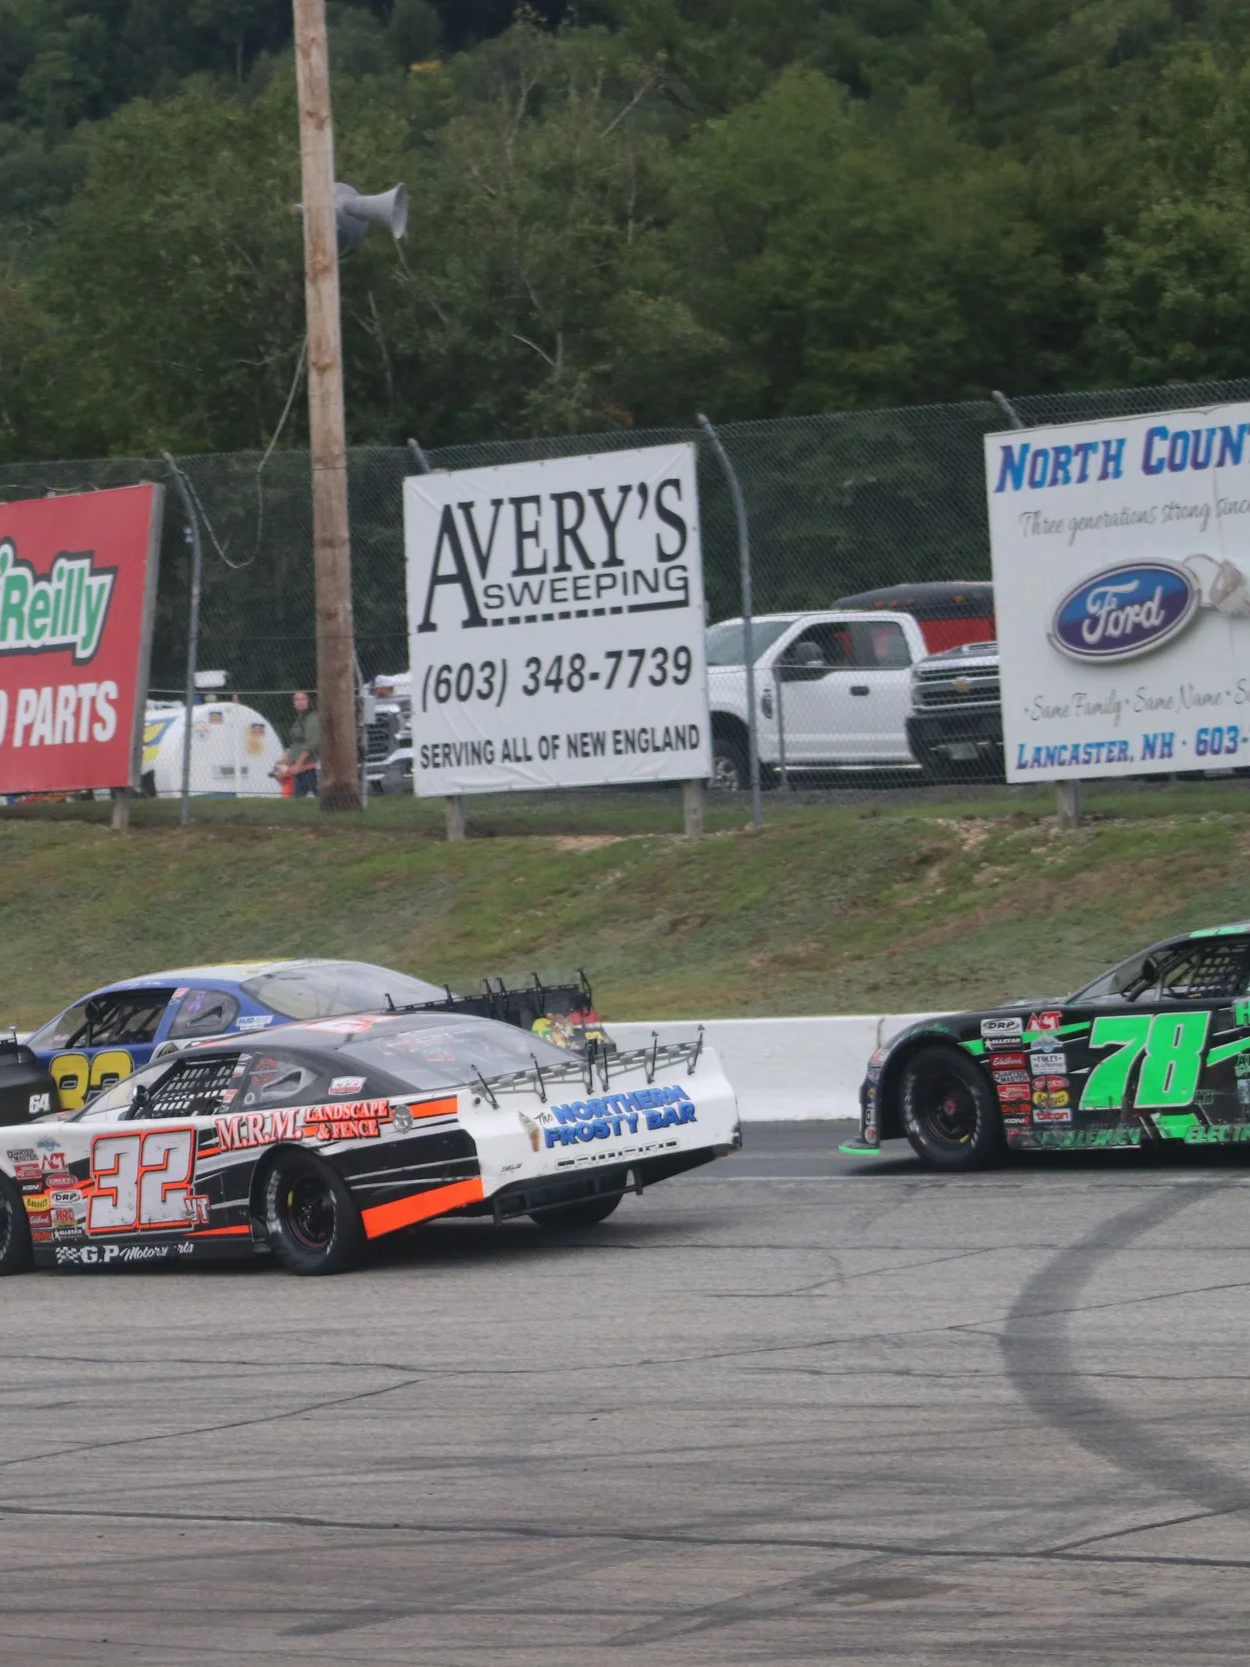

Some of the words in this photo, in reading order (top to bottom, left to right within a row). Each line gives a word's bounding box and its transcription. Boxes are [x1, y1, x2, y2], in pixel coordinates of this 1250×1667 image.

[994, 438, 1126, 493] NORTH
[1141, 424, 1250, 476] COUN
[1019, 509, 1063, 537] Three
[1067, 505, 1158, 546] generations
[1161, 501, 1211, 532] strong
[417, 478, 687, 633] AVERY'S
[483, 565, 689, 610] SWEEPING
[1081, 579, 1166, 644] Ford
[422, 657, 507, 712] (603)
[521, 645, 693, 698] 348-7739
[13, 680, 119, 748] PARTS
[1030, 695, 1070, 721] Same
[1071, 688, 1123, 727] Family
[1133, 686, 1172, 713] Same
[1175, 682, 1222, 713] Name
[420, 738, 495, 770] SERVING
[500, 737, 533, 763] ALL
[538, 734, 561, 760] OF
[567, 730, 607, 759] NEW
[612, 724, 700, 753] ENGLAND
[1015, 740, 1135, 770] LANCASTER,
[1140, 732, 1176, 761] NH
[989, 1021, 1015, 1029] DRP
[1026, 1011, 1062, 1031] ACT
[1079, 1010, 1212, 1110] 78
[28, 1092, 50, 1113] 64
[544, 1112, 639, 1149] FROSTY
[642, 1101, 698, 1131] BAR
[550, 1085, 692, 1125] NORTHERN
[216, 1109, 303, 1151] M.R.M.
[305, 1100, 389, 1122] LANDSCAPE
[316, 1120, 331, 1141] &
[332, 1119, 380, 1139] FENCE
[55, 1193, 78, 1201] DRP
[87, 1125, 197, 1234] 32
[183, 1194, 210, 1223] VT
